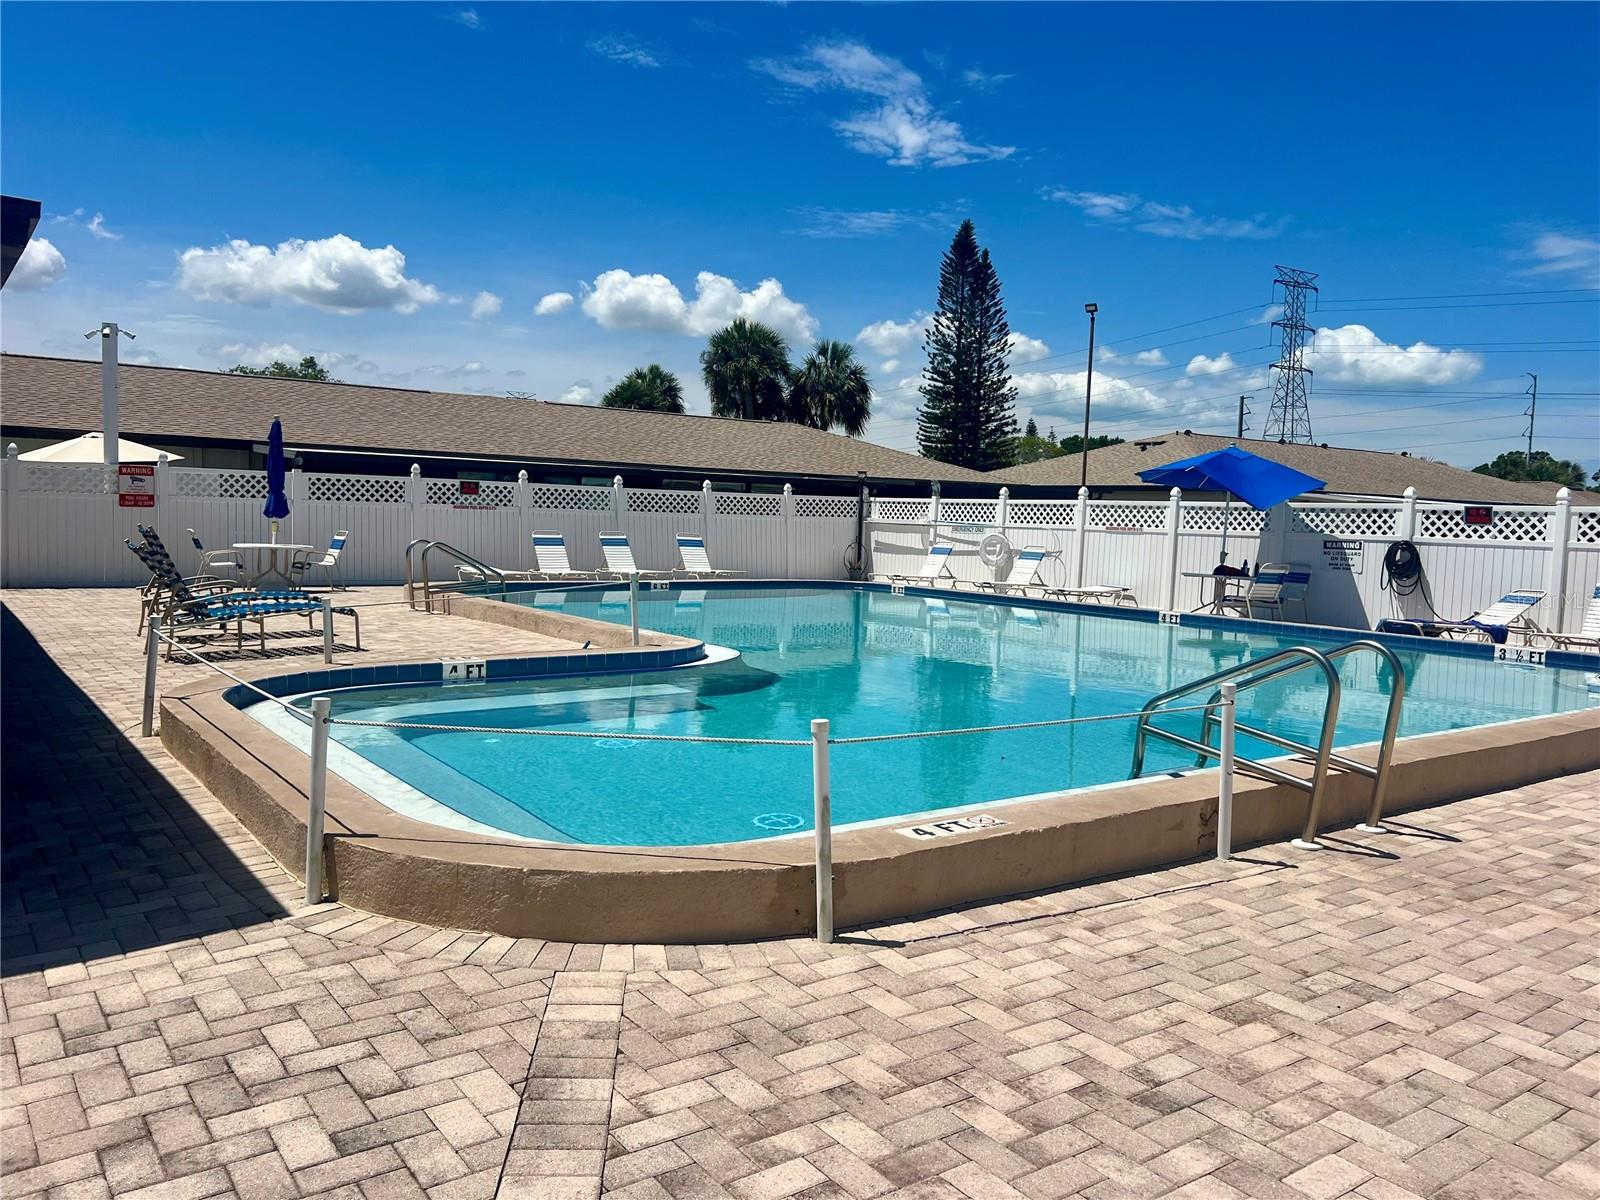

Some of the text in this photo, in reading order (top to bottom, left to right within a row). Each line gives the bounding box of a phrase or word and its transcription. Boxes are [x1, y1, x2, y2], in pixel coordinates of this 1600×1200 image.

[121, 466, 152, 475] WARNING
[1325, 541, 1360, 549] WARNING
[1499, 648, 1507, 661] 3
[912, 827, 937, 837] 4
[932, 820, 972, 833] FT
